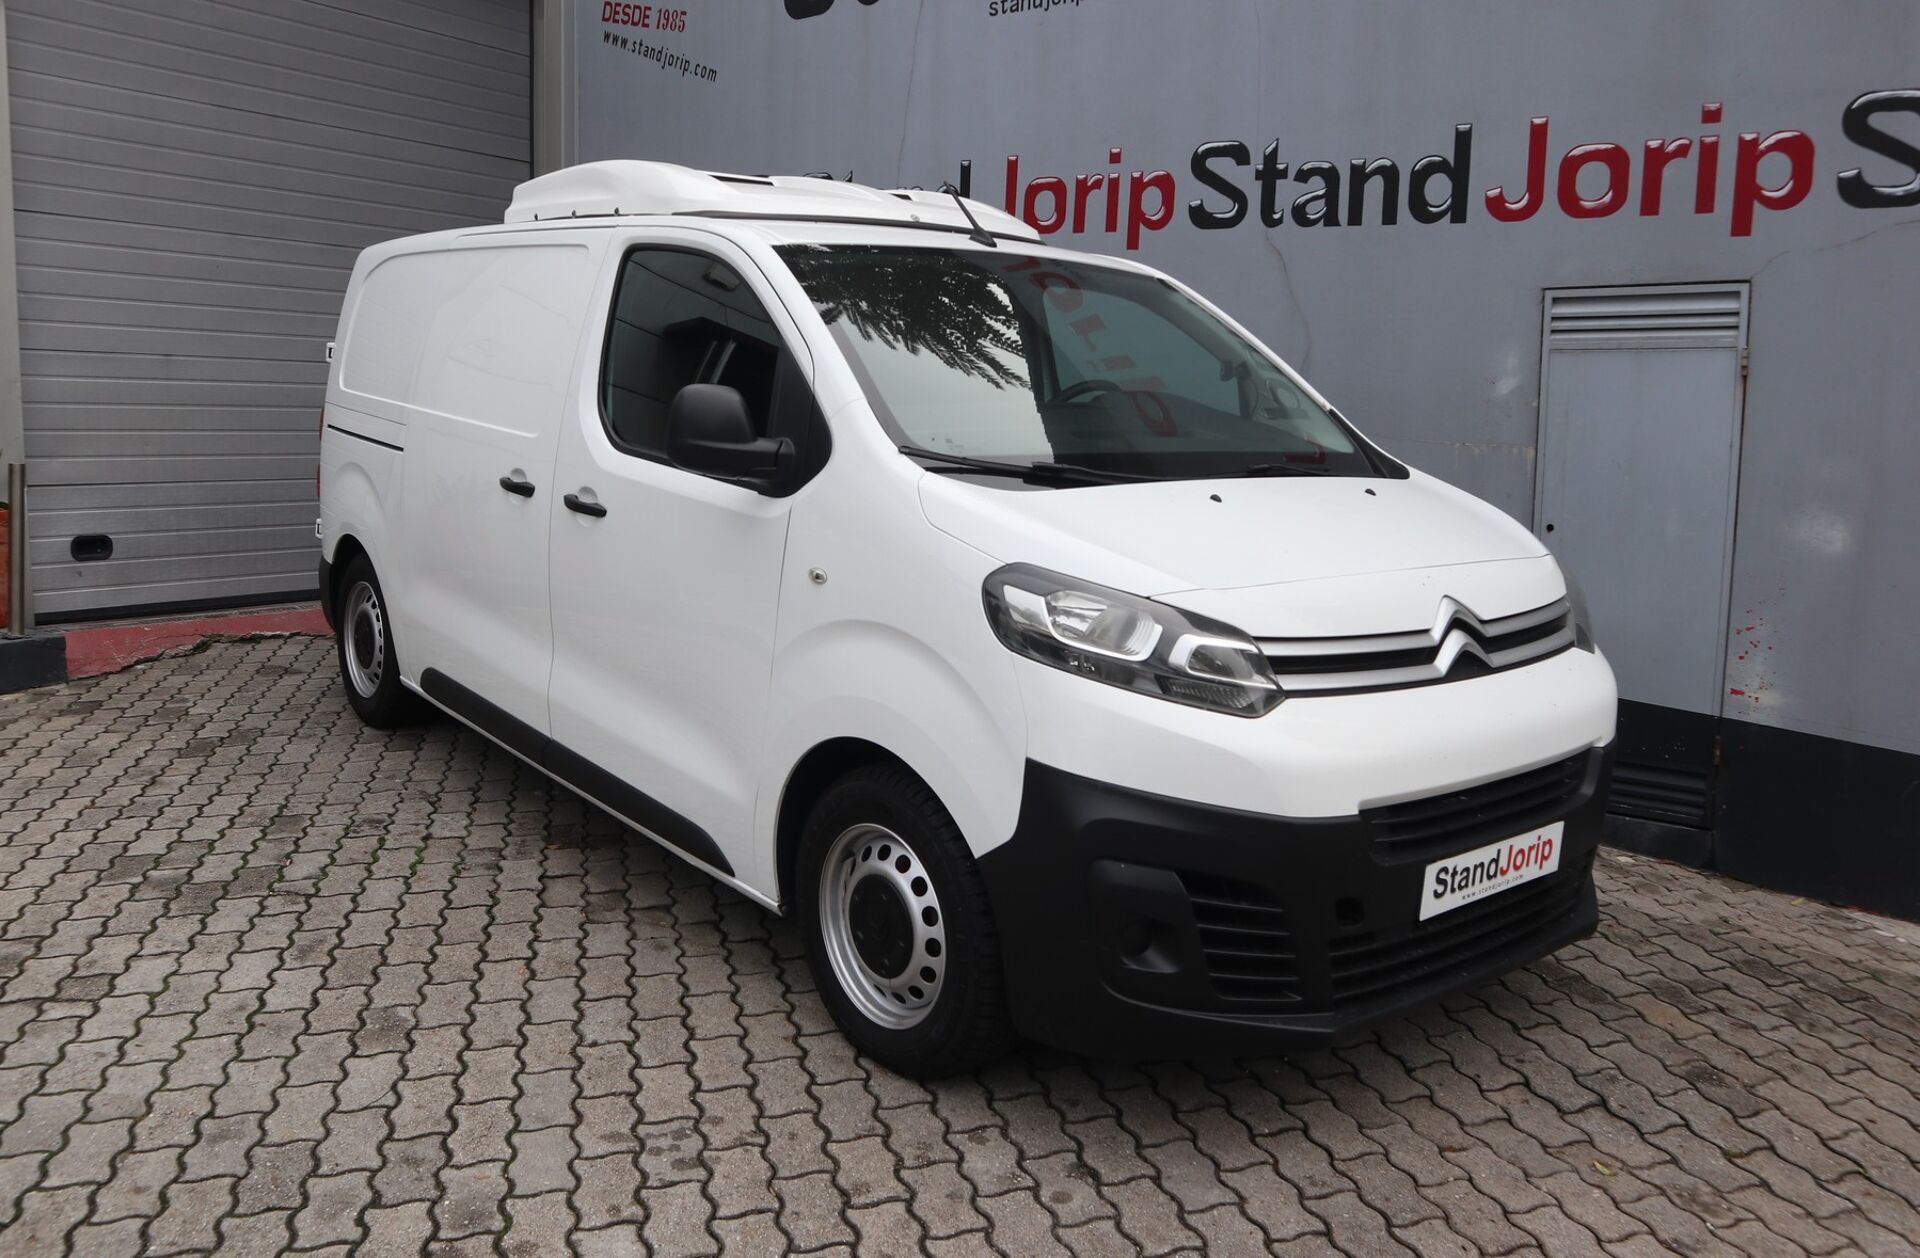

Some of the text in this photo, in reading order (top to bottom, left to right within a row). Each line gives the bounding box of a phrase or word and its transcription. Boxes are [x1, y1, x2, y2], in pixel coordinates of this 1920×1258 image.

[602, 0, 687, 32] DESDE 1985
[603, 30, 718, 82] www.standjorip.com
[1188, 122, 1473, 230] Stand
[1485, 102, 1815, 238] Jorip
